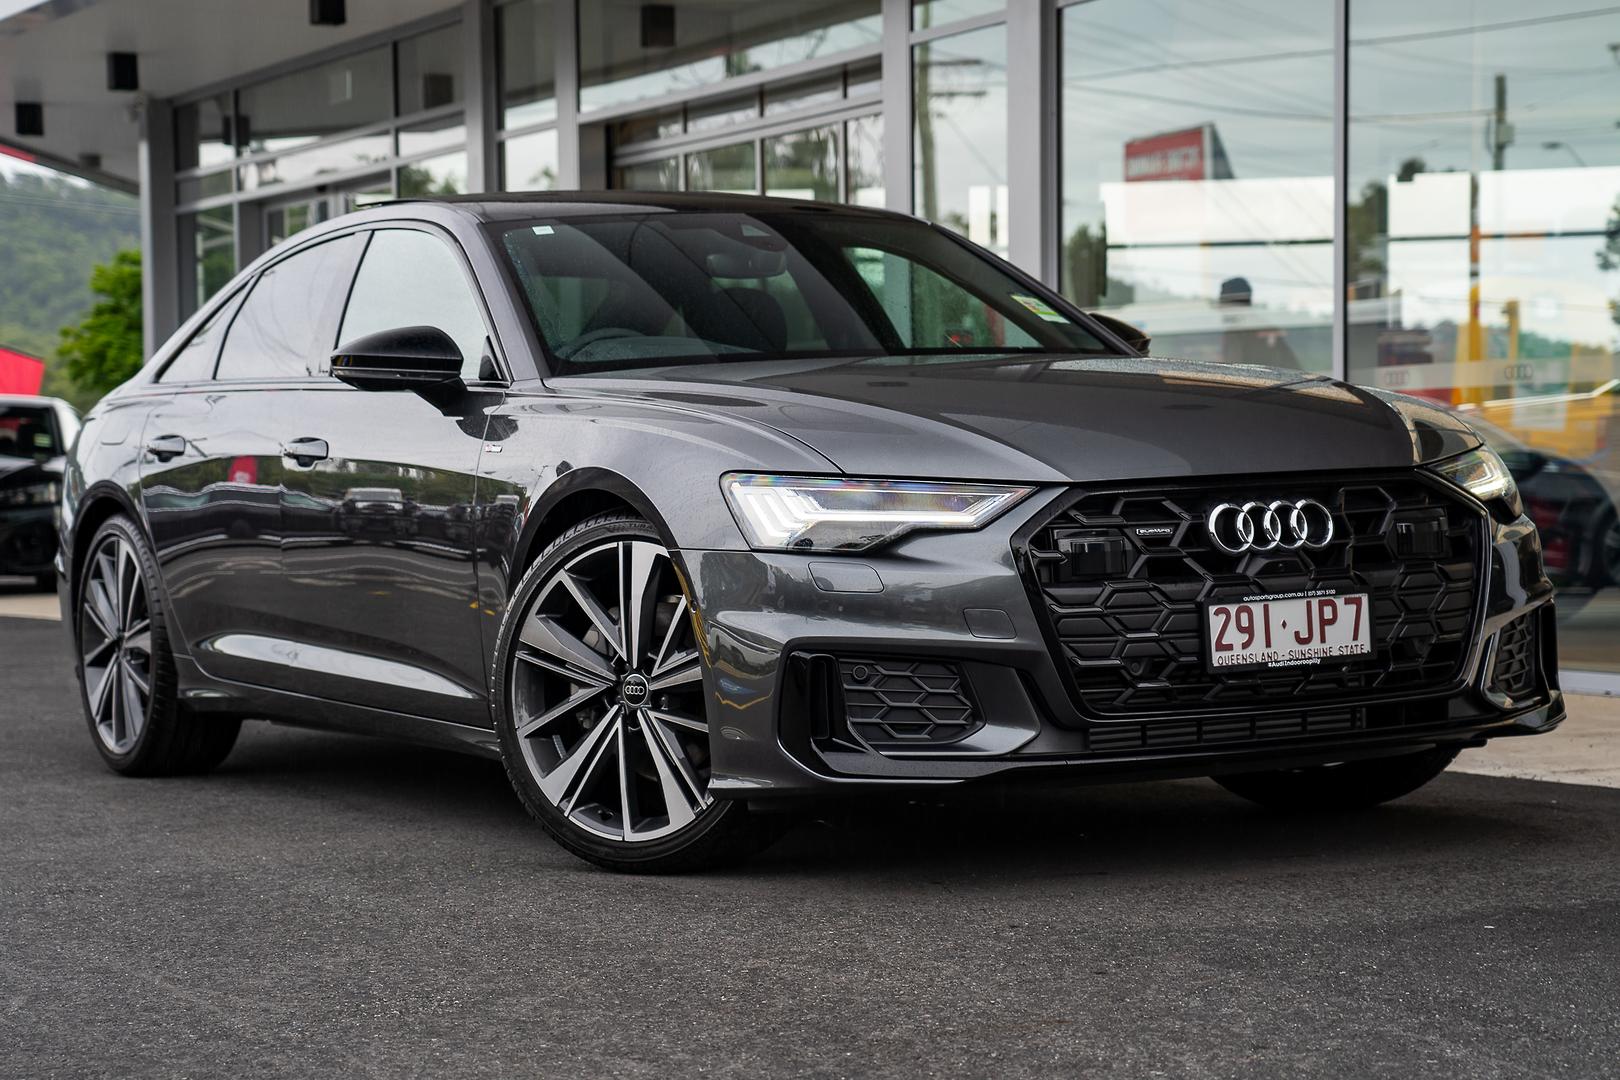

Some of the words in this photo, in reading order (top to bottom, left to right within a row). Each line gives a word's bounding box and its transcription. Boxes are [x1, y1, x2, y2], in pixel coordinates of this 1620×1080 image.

[1217, 651, 1279, 666] QUEENSLAND
[1288, 647, 1333, 660] SUNSHINE
[1338, 644, 1365, 655] STATE
